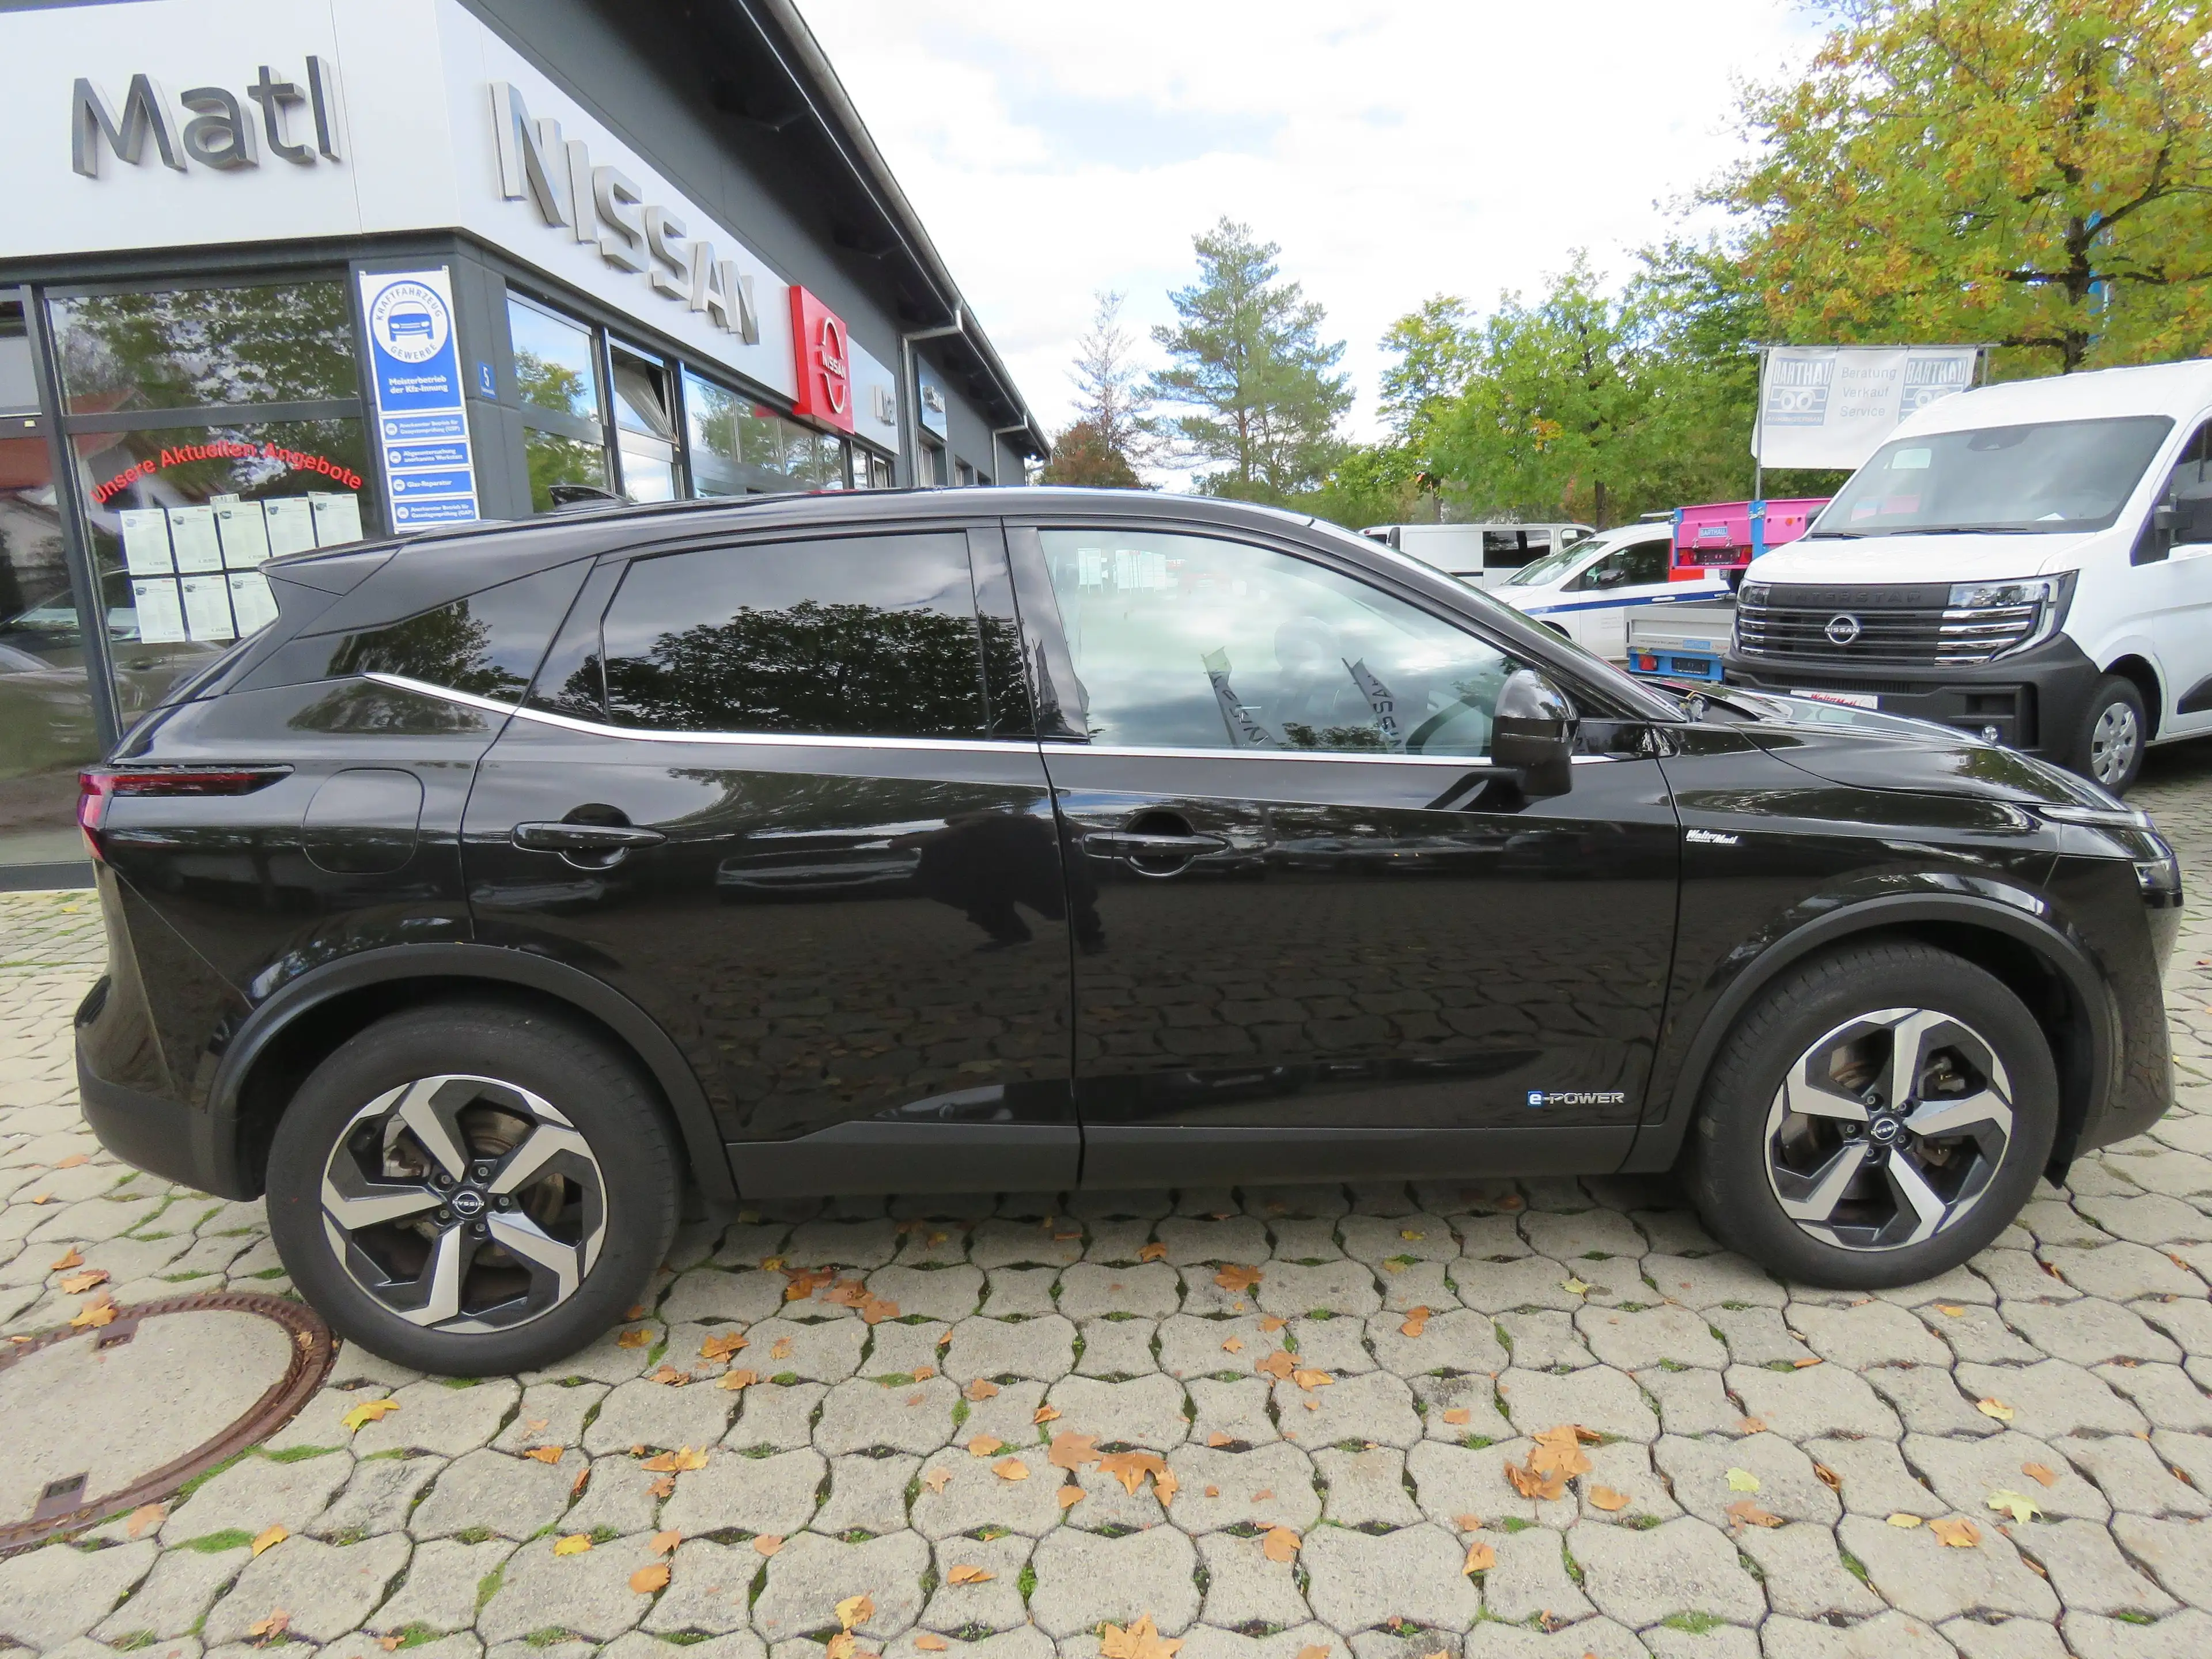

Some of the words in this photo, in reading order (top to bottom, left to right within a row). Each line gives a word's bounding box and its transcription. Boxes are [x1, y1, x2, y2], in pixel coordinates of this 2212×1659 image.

[73, 55, 341, 177] Matl
[488, 81, 760, 346] NISSAN
[376, 287, 442, 320] KRAFTFAHRZEUG
[391, 343, 437, 360] GEWERBE
[822, 350, 846, 380] NISSAN
[483, 366, 490, 387] 5
[1773, 361, 1834, 385] BARTHAU
[1841, 367, 1897, 381] Beratung
[1905, 361, 1967, 384] BARTHAU
[388, 375, 447, 385] Meisterbetrieb
[390, 386, 404, 394] der
[406, 384, 449, 393] Kfz-Innung
[1843, 387, 1890, 397] Verkauf
[1839, 406, 1886, 417] Service
[90, 459, 157, 503] Unsere
[160, 440, 256, 468] Aktuellen
[263, 442, 362, 489] Angebote
[1700, 529, 1726, 537] BARTHAU
[1787, 591, 1921, 603] INTERSTAR
[1685, 830, 1718, 839] Walter
[1712, 834, 1738, 844] Matl
[1528, 1092, 1624, 1105] e-POWER
[1870, 1124, 1899, 1135] NISSAN
